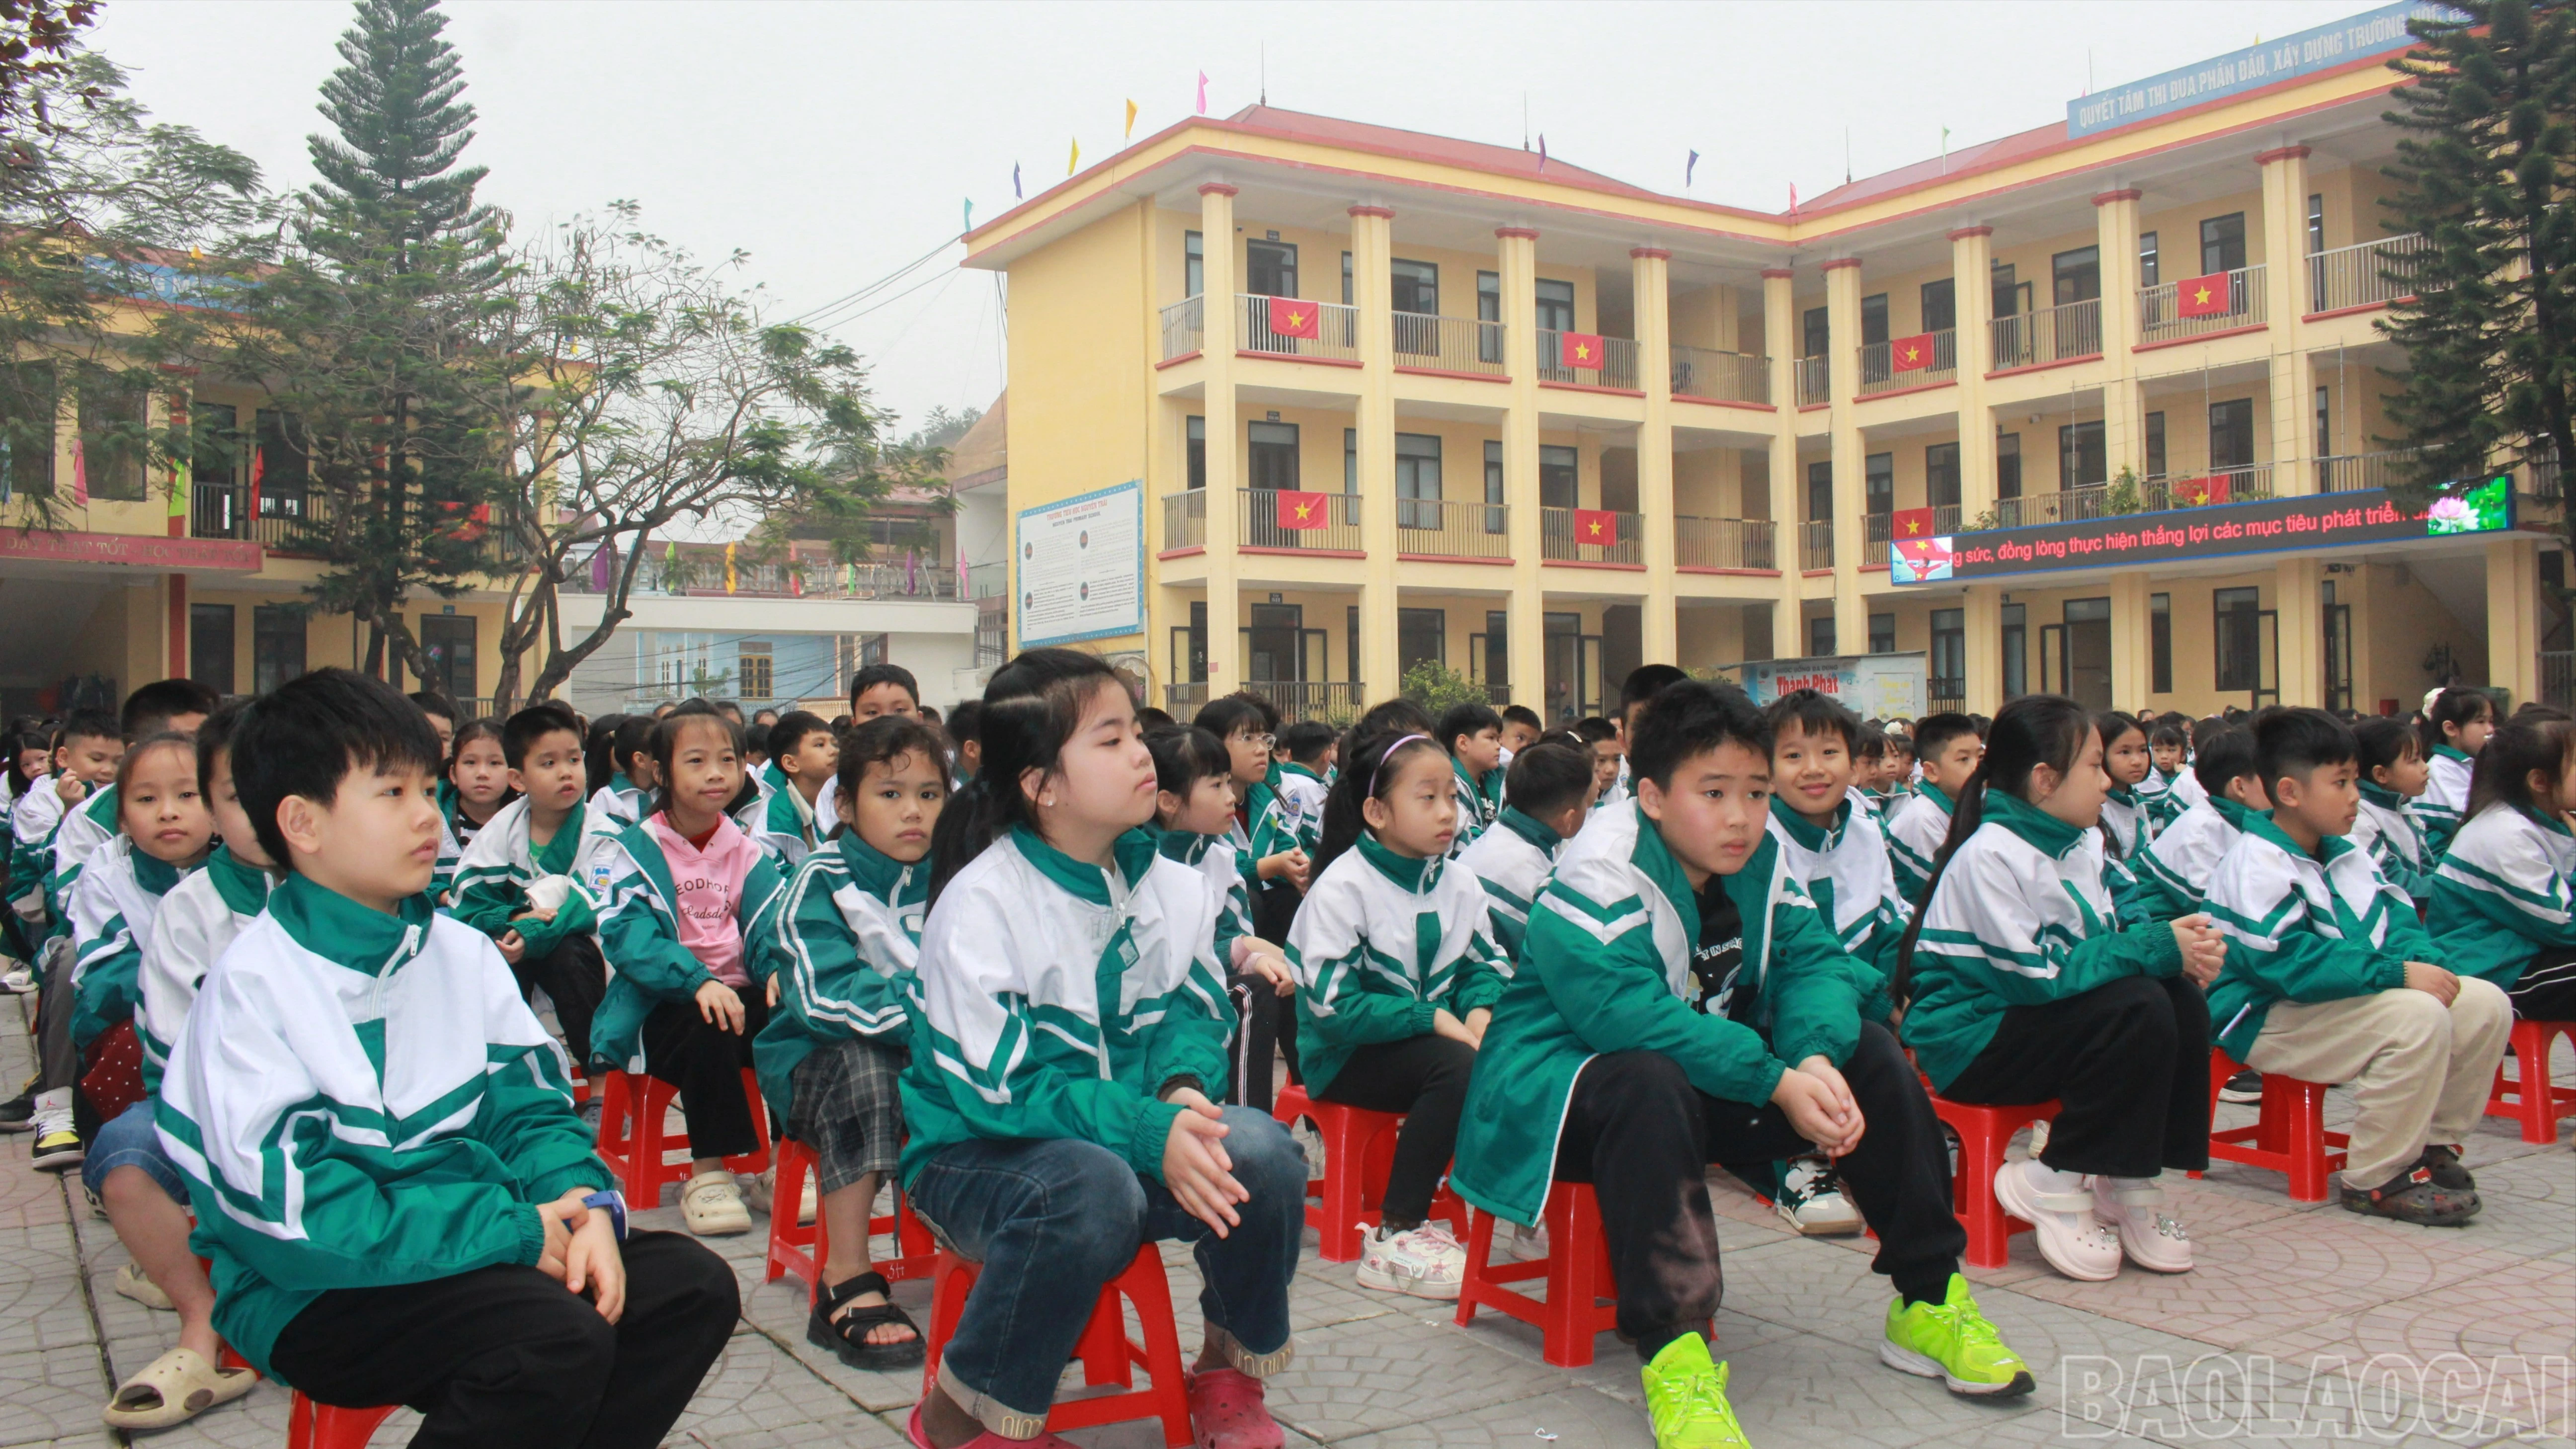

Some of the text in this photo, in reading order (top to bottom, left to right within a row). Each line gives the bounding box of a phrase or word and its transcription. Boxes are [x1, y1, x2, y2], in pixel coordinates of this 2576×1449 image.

[2079, 93, 2114, 129] QUYẾT
[2118, 89, 2144, 115] TÂM
[2148, 83, 2167, 107] THI
[2170, 76, 2196, 101] ĐUA
[2199, 59, 2235, 93] PHẤN
[2273, 43, 2299, 72] XÂY
[2304, 32, 2342, 65] DỰNG
[2346, 14, 2406, 50] TRƯỜNG
[97, 537, 129, 556] TỐT
[1966, 547, 1995, 563] sức,
[1998, 540, 2032, 561] đồng
[2036, 540, 2066, 559] lòng
[2069, 536, 2102, 554] thực
[2105, 532, 2137, 551] hiện
[2141, 525, 2184, 547] thắng
[2189, 524, 2209, 544] lợi
[2213, 521, 2243, 539] các
[2246, 520, 2282, 538] mục
[2285, 514, 2318, 533] tiêu
[2322, 508, 2362, 533] phát
[1776, 672, 1839, 696] Thành Phát
[1710, 945, 1721, 957] IN
